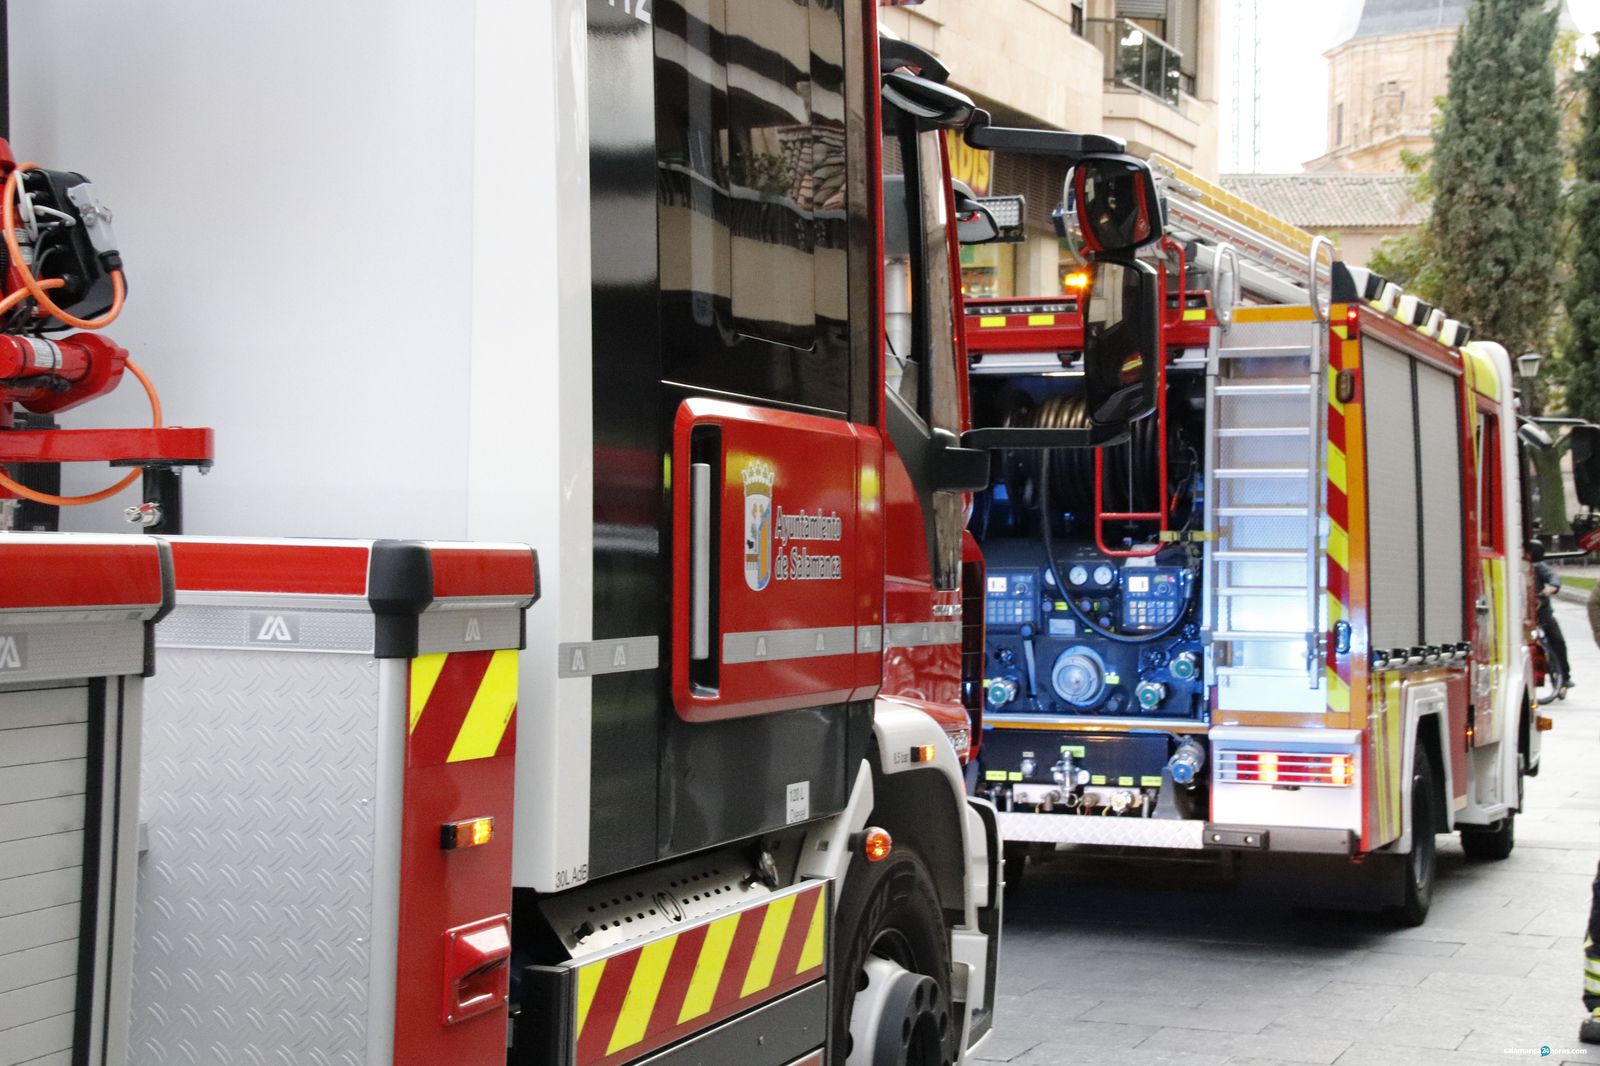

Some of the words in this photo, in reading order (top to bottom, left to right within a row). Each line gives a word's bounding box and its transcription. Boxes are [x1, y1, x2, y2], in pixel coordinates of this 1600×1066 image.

[775, 505, 842, 546] Ayuntamiento
[775, 546, 788, 580] de
[790, 546, 842, 580] Salamanca
